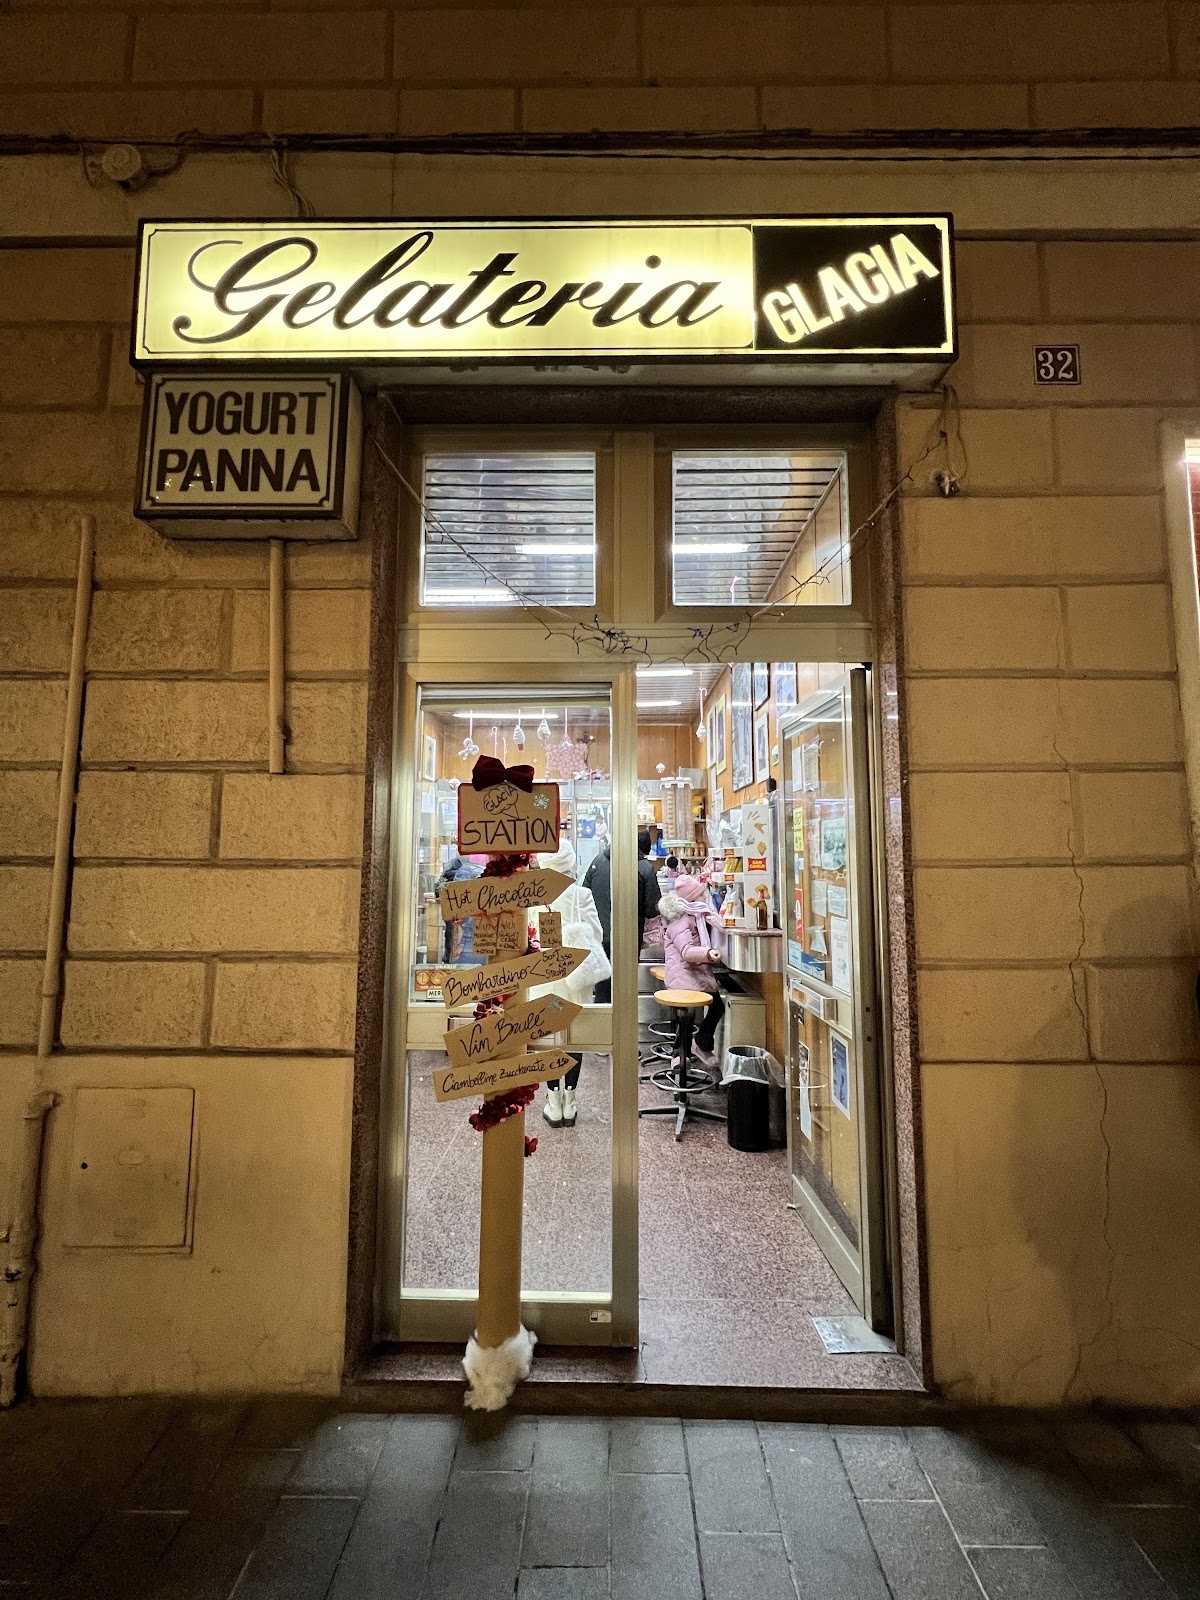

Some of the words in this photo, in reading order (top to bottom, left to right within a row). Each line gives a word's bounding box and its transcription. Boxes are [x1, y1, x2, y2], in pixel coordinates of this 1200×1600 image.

[173, 231, 725, 344] Gelateria
[762, 233, 940, 343] GLACIA
[1037, 350, 1074, 380] 32
[164, 390, 327, 436] YOGURT
[155, 448, 321, 493] PANNA
[446, 889, 472, 911] Hot
[477, 878, 548, 910] Chocolate
[445, 966, 531, 1006] Bombardino
[460, 1023, 493, 1057] Vin
